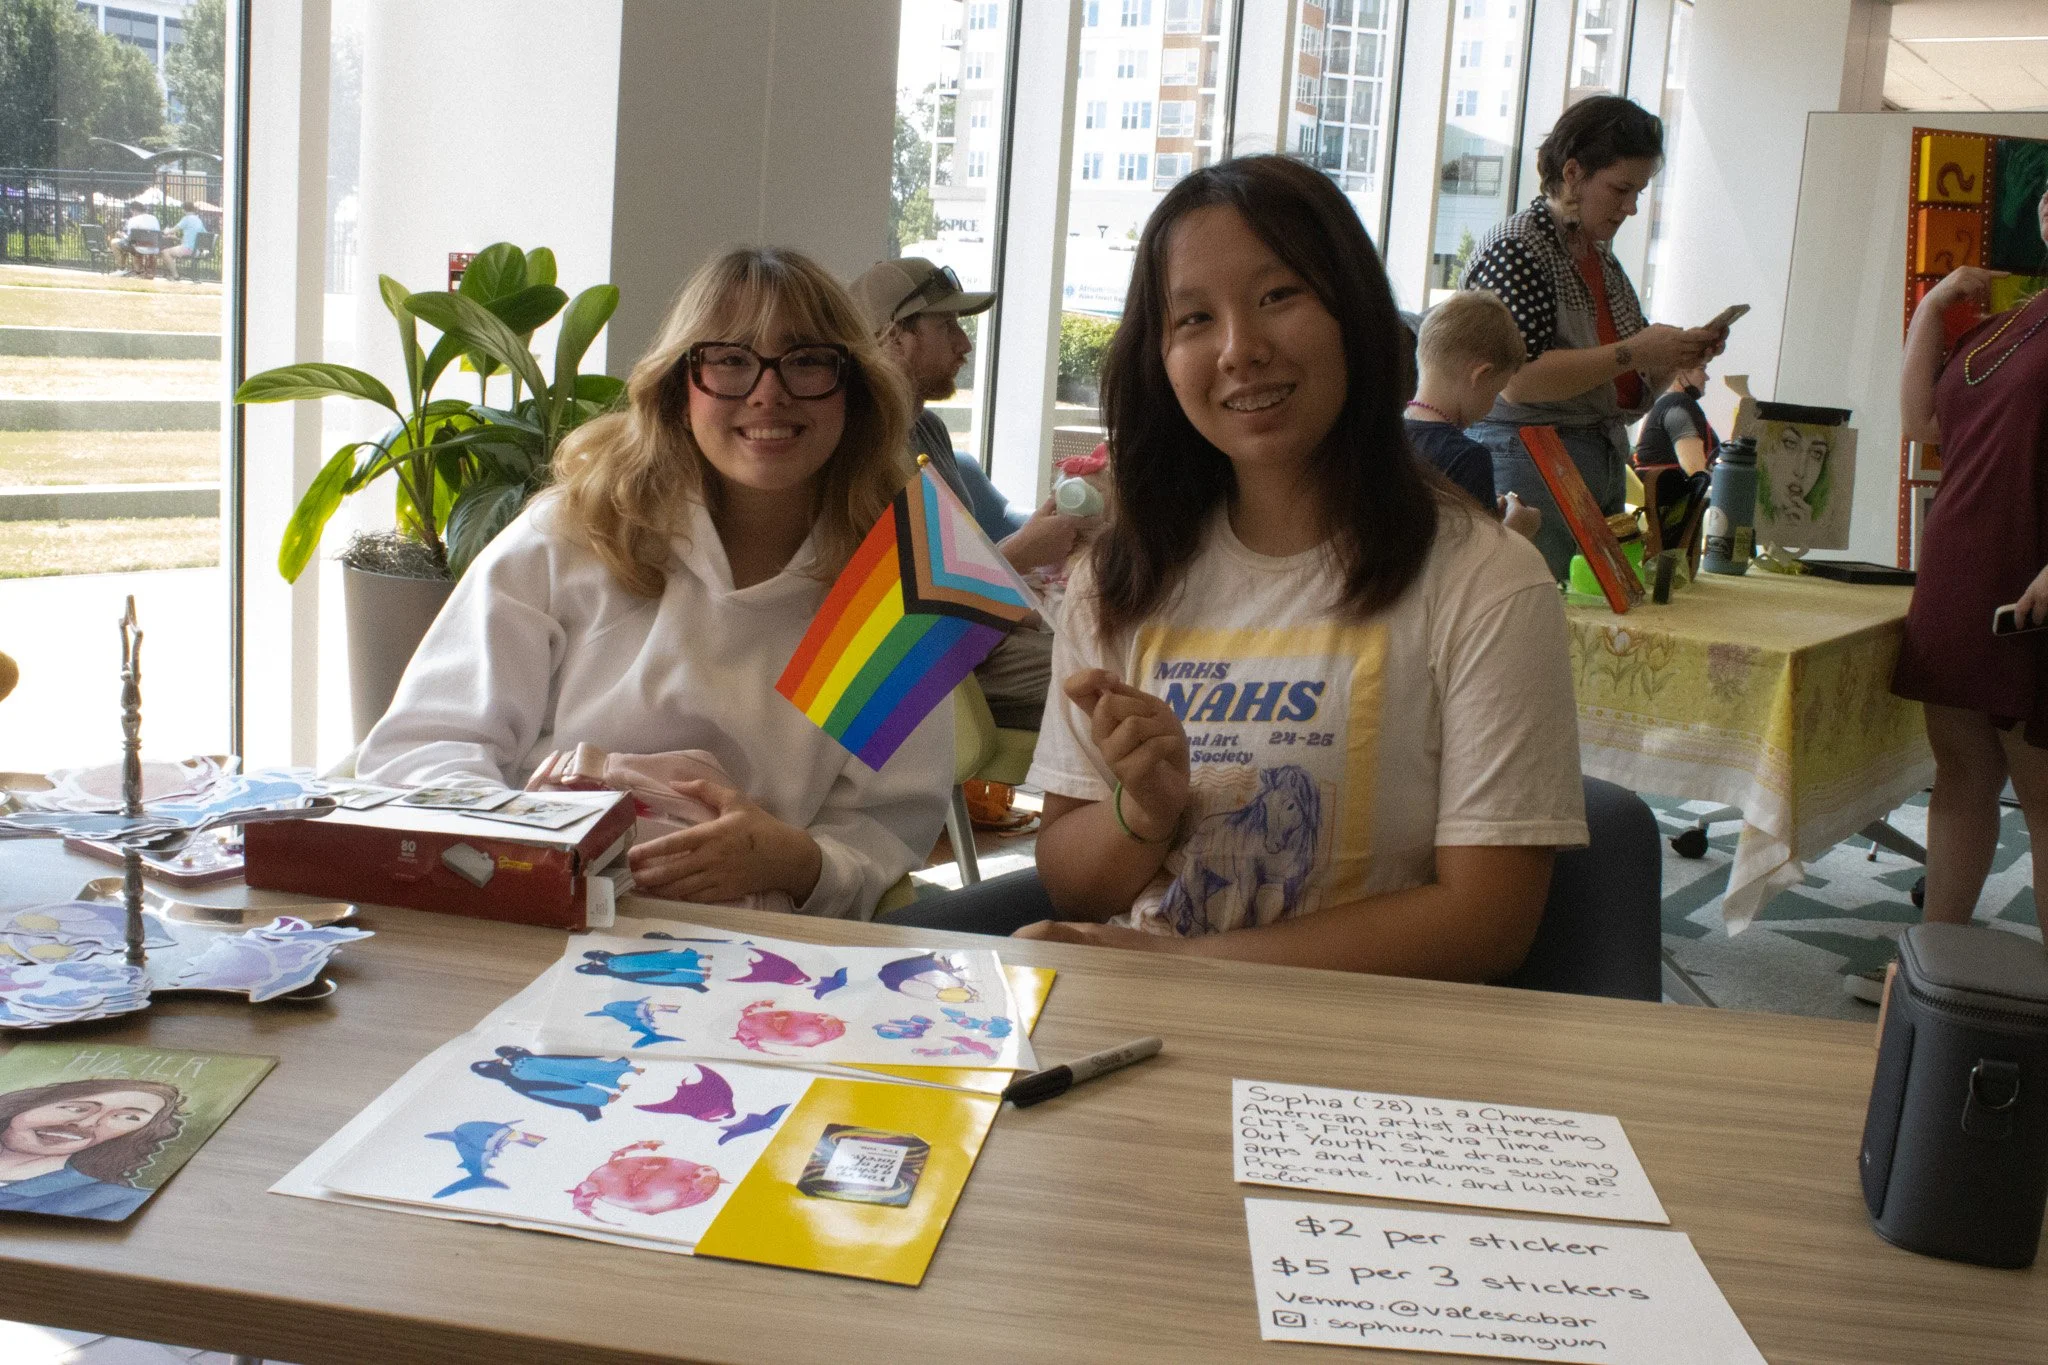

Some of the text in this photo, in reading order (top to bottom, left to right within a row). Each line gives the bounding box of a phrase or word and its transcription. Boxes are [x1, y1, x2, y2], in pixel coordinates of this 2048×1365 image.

[1154, 661, 1231, 680] MRHS
[1165, 681, 1326, 722] NAHS
[1210, 733, 1239, 747] Art
[1268, 731, 1335, 747] 24-25
[1191, 750, 1254, 766] Society
[401, 839, 417, 853] 80
[1248, 1085, 1343, 1110] Sophia
[1424, 1106, 1444, 1117] is
[1456, 1108, 1470, 1119] a
[1479, 1107, 1581, 1129] Chinese
[1243, 1103, 1606, 1150] American artist attending
[1323, 1123, 1434, 1141] Flourish
[1441, 1136, 1481, 1146] via
[1487, 1137, 1555, 1153] Time
[1241, 1127, 1290, 1143] Out
[1400, 1142, 1450, 1158] She
[1464, 1150, 1544, 1166] draws
[1550, 1158, 1620, 1178] using
[1244, 1142, 1617, 1188] apps and mediums such as
[1461, 1178, 1514, 1193] and
[1295, 1215, 1609, 1256] $2 per sticker
[1272, 1256, 1651, 1300] $5 per 3 stickers
